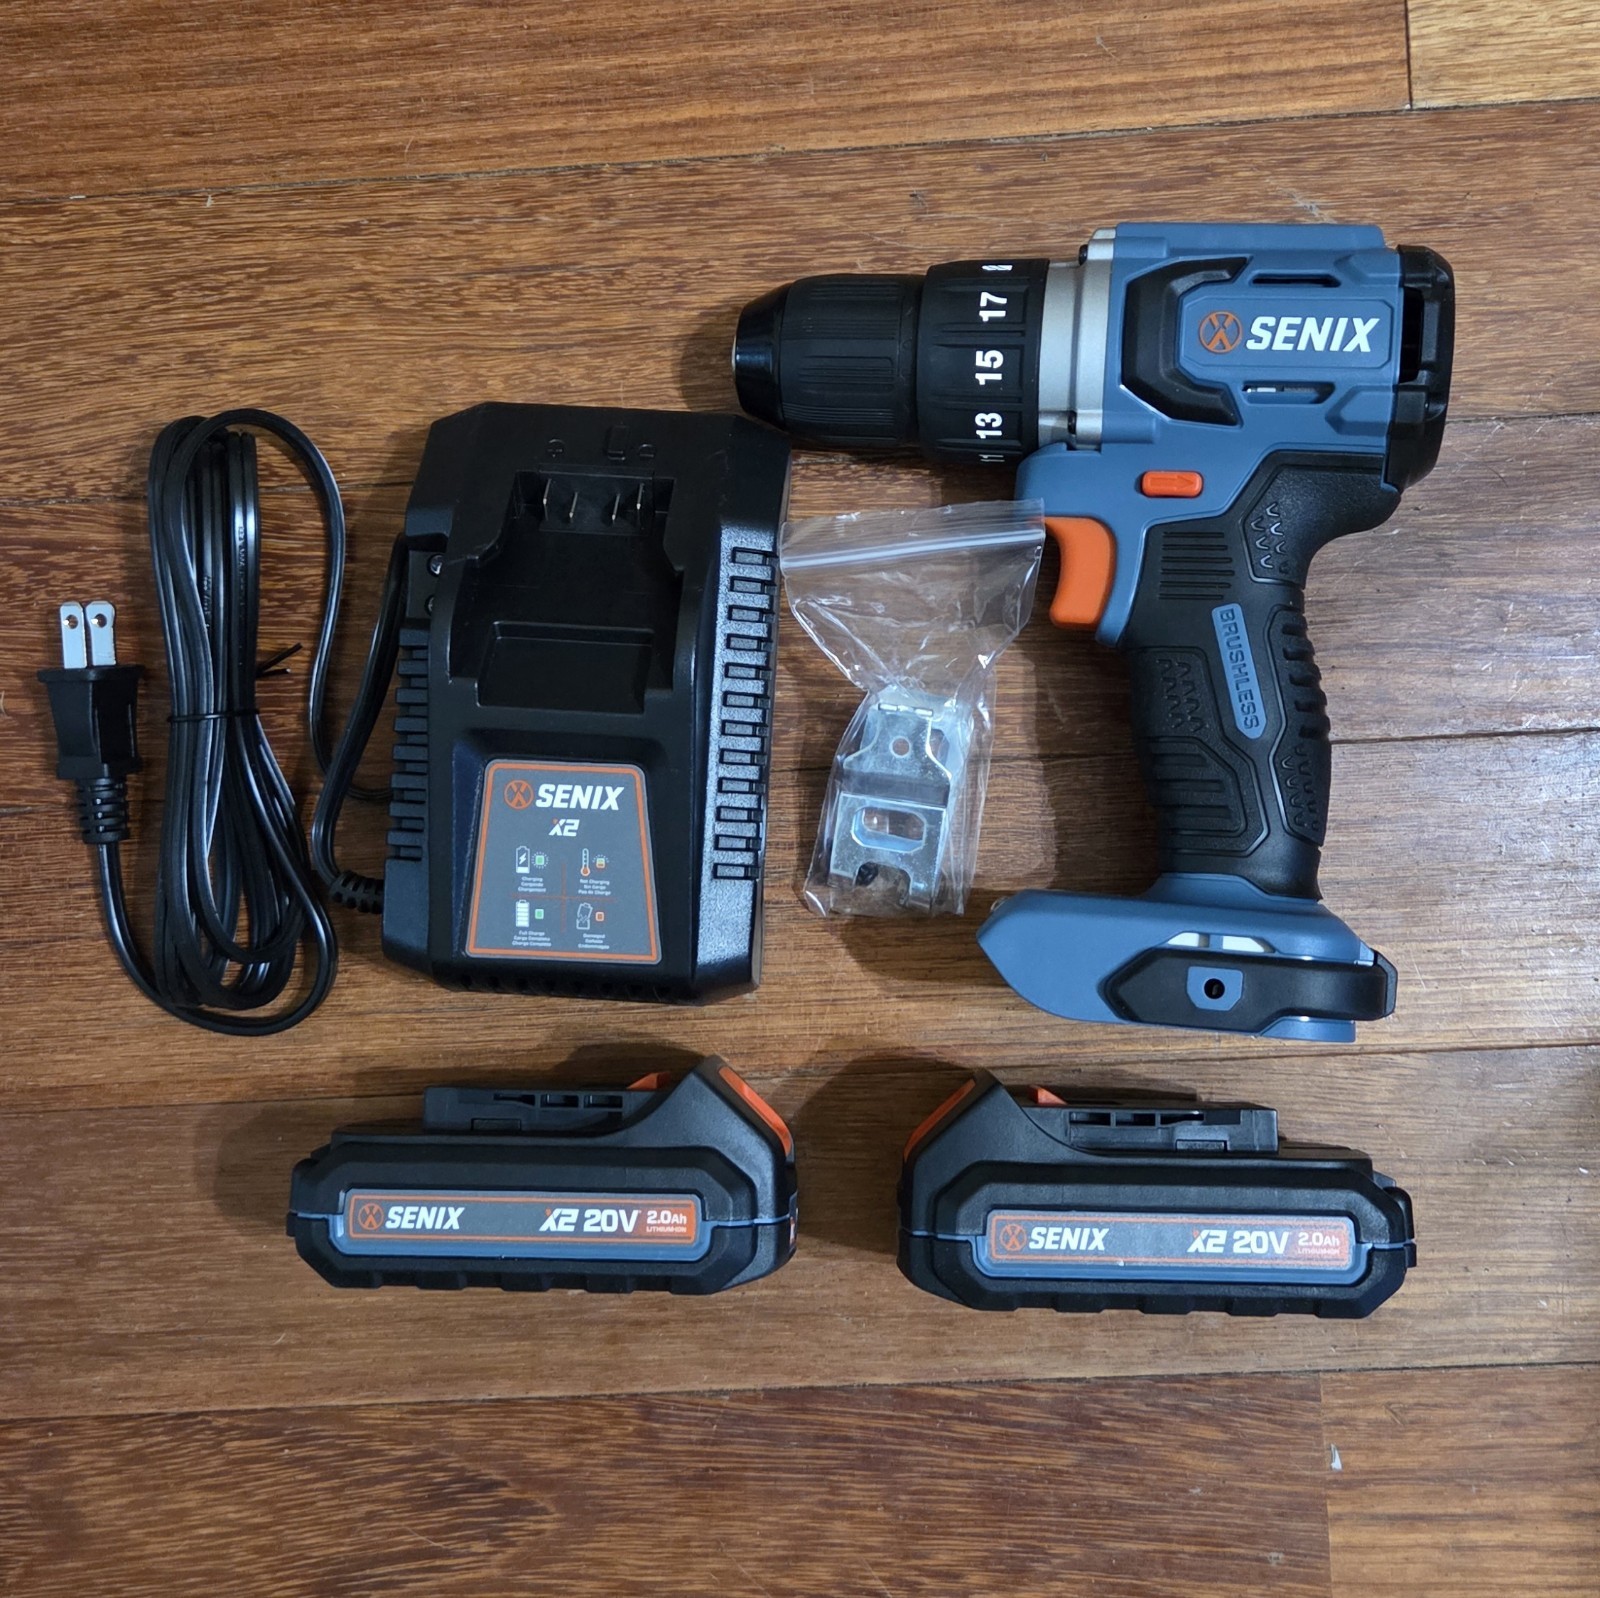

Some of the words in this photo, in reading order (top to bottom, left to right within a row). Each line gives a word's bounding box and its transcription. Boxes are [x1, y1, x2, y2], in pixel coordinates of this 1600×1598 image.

[979, 291, 1007, 323] 17
[1245, 315, 1381, 354] SENIX
[975, 349, 1004, 386] 15
[975, 412, 1004, 441] 13
[1219, 607, 1261, 730] BRUSHLESS
[535, 783, 625, 811] SENIX
[548, 817, 580, 837] X2
[385, 1205, 465, 1231] SENIX
[538, 1207, 578, 1233] X2
[582, 1208, 639, 1234] 20V
[646, 1209, 688, 1226] 2.0Ah
[1028, 1226, 1110, 1252] SENIX
[1187, 1229, 1226, 1254] X2
[1232, 1230, 1290, 1255] 20V
[1297, 1231, 1341, 1247] 2.0Ah
